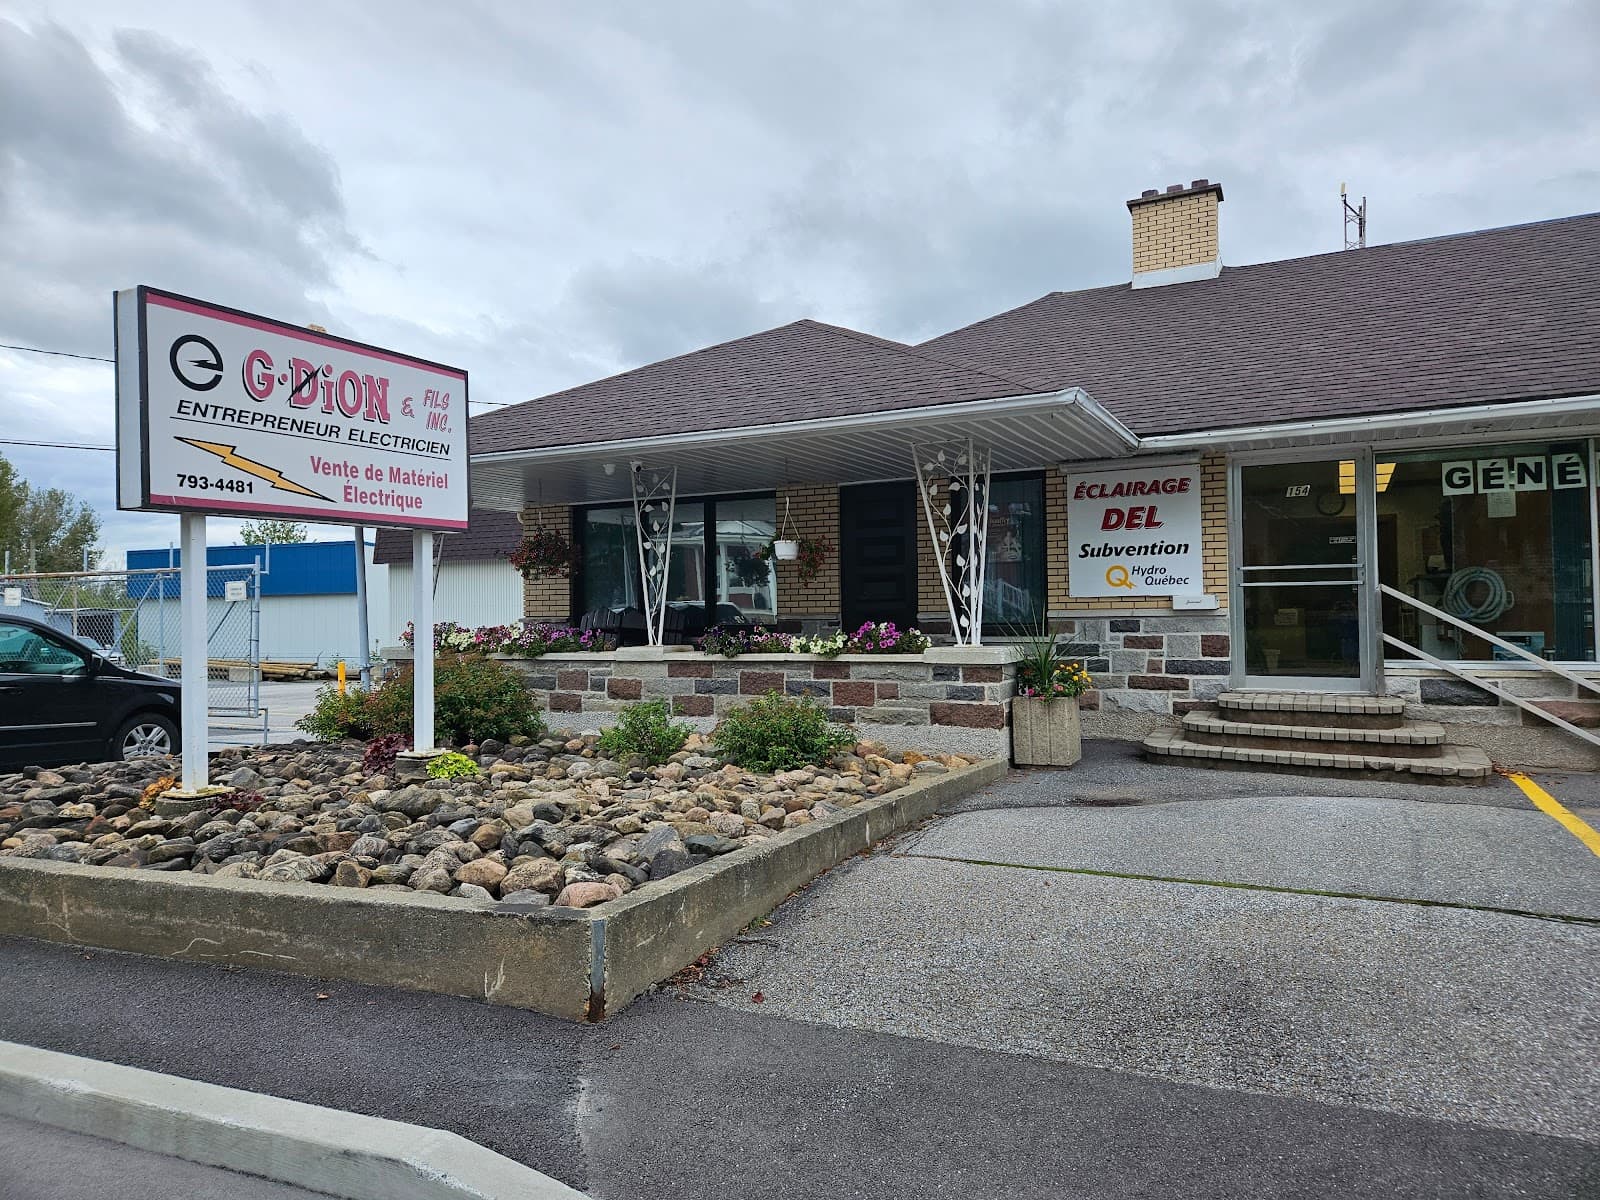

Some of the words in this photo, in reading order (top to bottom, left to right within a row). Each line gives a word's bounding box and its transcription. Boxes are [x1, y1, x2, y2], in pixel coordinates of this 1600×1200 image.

[401, 397, 415, 419] &
[423, 389, 450, 410] FILS
[176, 400, 341, 438] ENTREPRENEUR
[347, 428, 450, 455] ELECTRICIEN
[425, 411, 452, 433] INC.
[310, 455, 359, 479] Vente
[364, 463, 384, 482] de
[388, 466, 449, 489] Matériel
[176, 474, 254, 494] 793-4481
[1073, 477, 1192, 500] ÉCLAIRAGE
[1286, 485, 1310, 497] 154
[343, 480, 423, 512] Électrique
[1100, 505, 1164, 532] DEL
[1078, 540, 1190, 559] Subvention
[1131, 565, 1167, 577] Hydro
[1144, 575, 1190, 586] Québec
